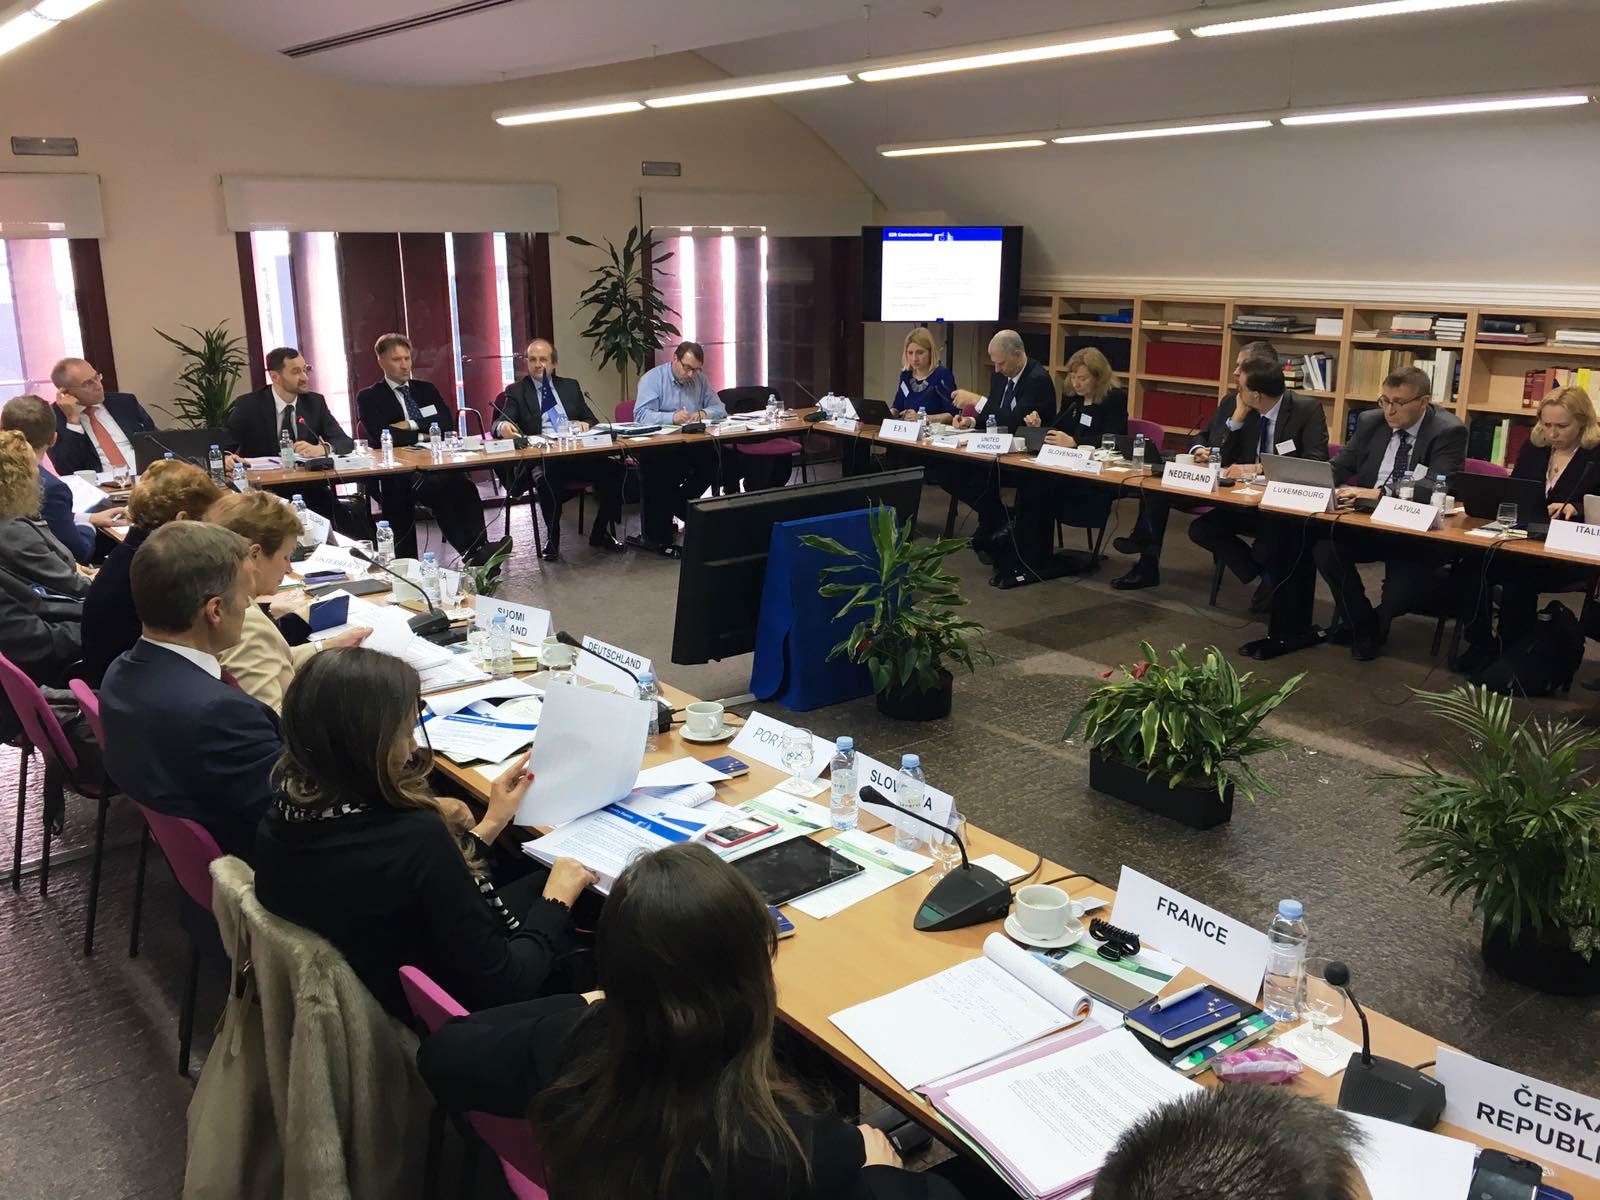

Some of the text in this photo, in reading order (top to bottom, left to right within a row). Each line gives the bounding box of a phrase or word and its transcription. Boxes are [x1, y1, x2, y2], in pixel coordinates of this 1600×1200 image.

[893, 425, 907, 433] EEA
[1047, 449, 1083, 459] SLOVENSKO
[1168, 468, 1211, 484] NEDERLAND
[1273, 486, 1324, 499] LUXEMBOURG
[1393, 504, 1421, 516] LATVIJA
[588, 641, 642, 670] DEUTSCHLAND
[1156, 896, 1229, 945] FRANCE
[1513, 1084, 1600, 1133] ČESK
